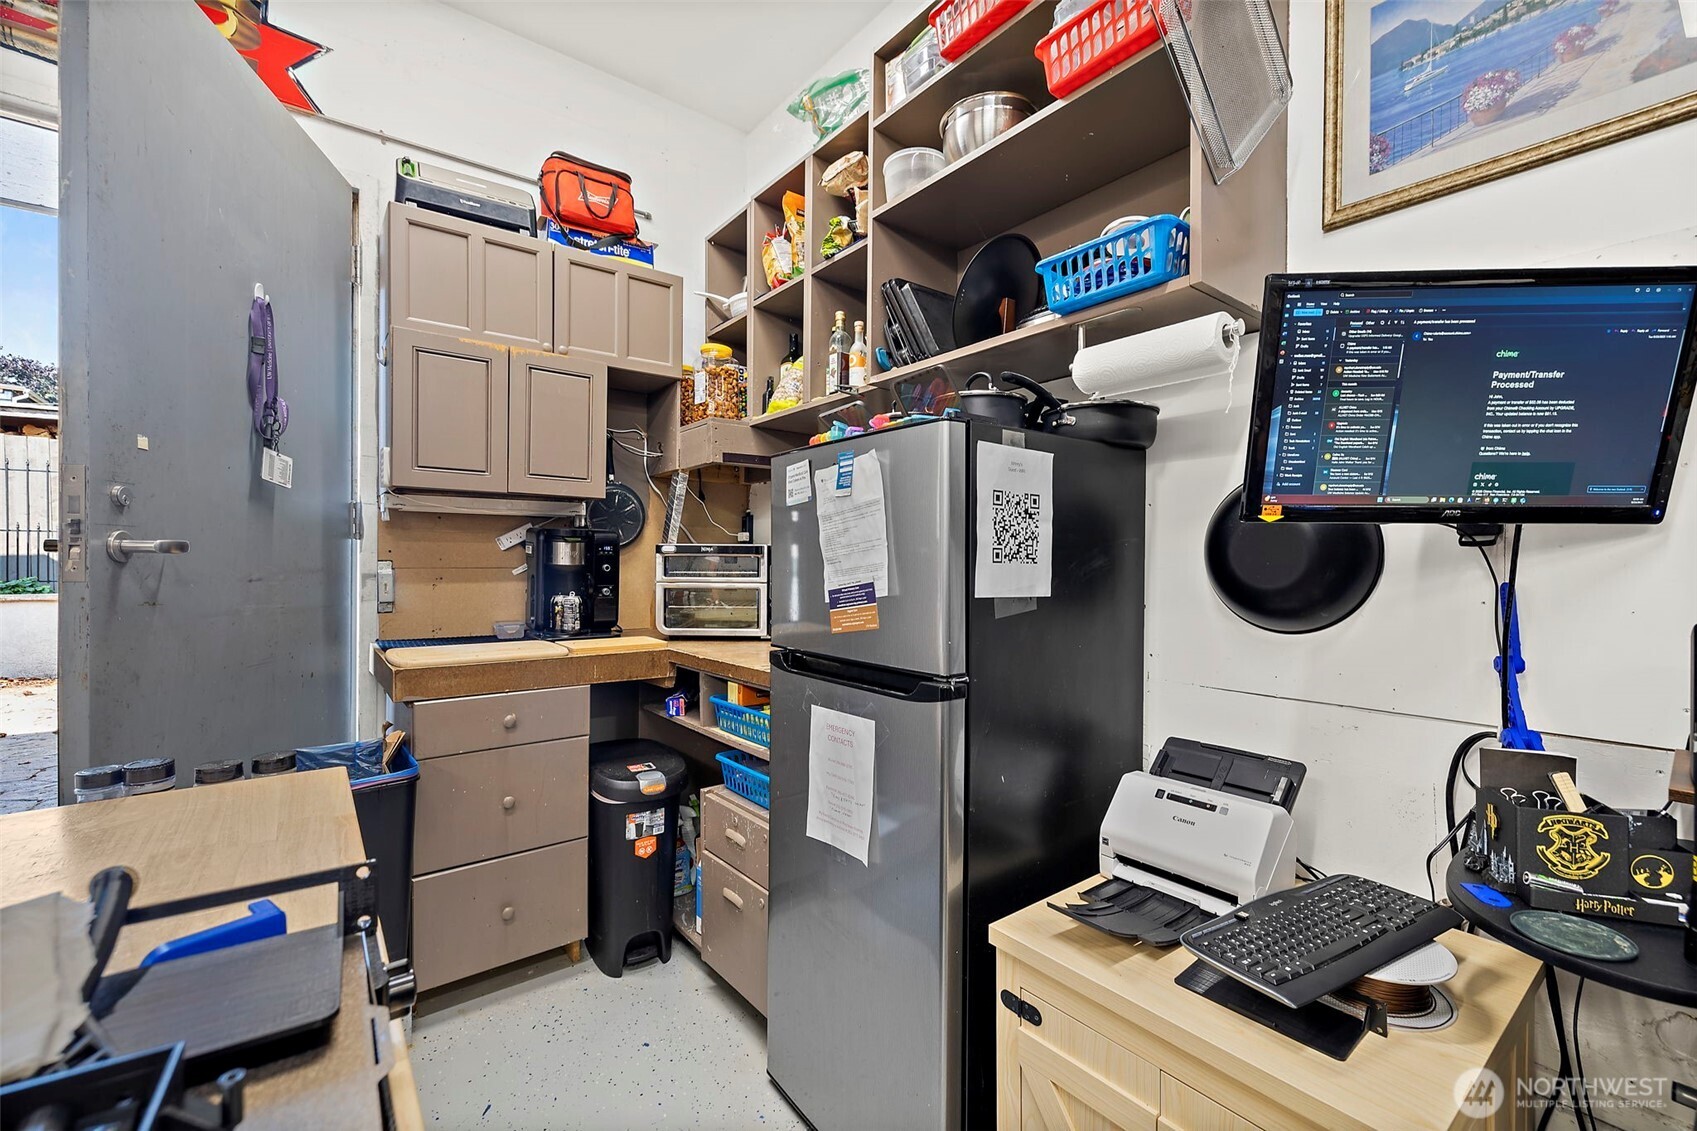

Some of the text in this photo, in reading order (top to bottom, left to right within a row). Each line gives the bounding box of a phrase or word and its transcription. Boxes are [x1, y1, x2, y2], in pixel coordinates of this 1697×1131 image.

[1496, 350, 1520, 358] chime
[1492, 370, 1565, 380] Payment/Transfer
[1490, 380, 1535, 388] Processed
[826, 723, 855, 737] EMERGENCY
[827, 735, 854, 748] CONTACTS
[1172, 815, 1196, 827] Canon
[1550, 817, 1598, 830] HOGWARTS
[1575, 898, 1635, 917] Harry Potter
